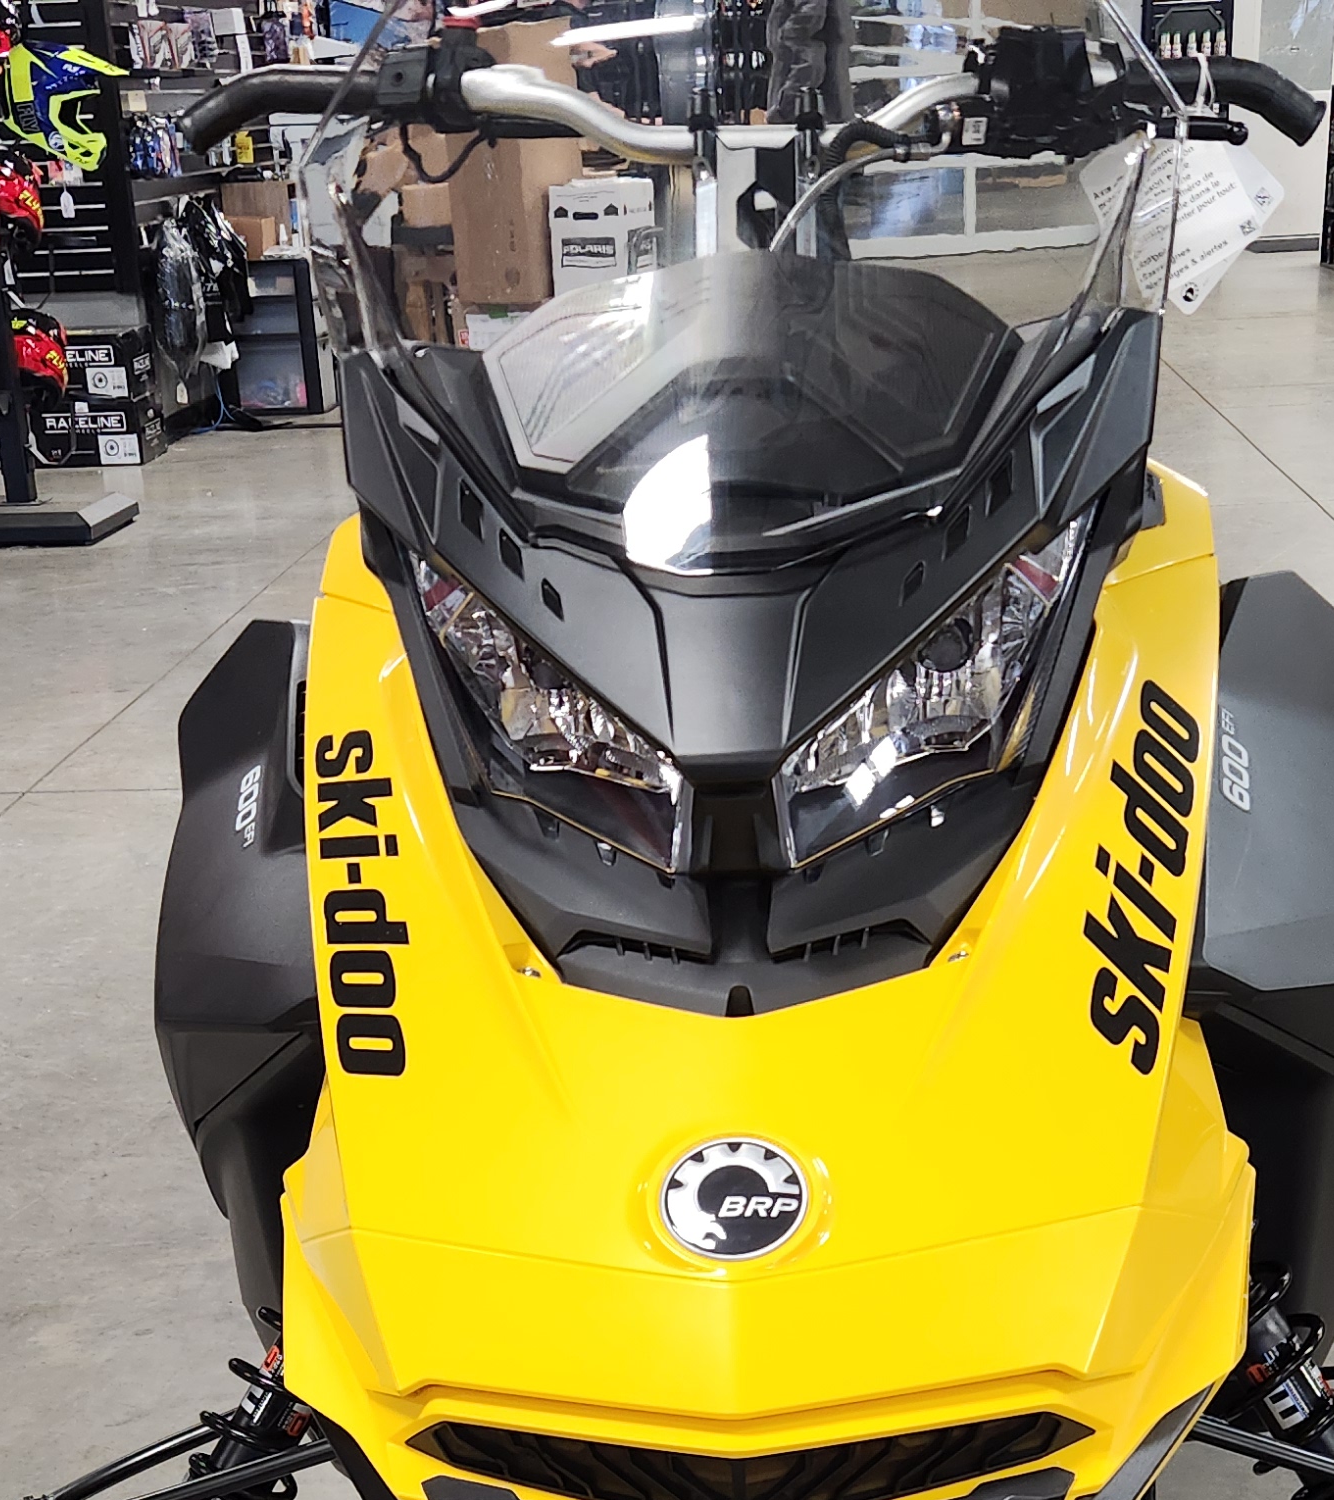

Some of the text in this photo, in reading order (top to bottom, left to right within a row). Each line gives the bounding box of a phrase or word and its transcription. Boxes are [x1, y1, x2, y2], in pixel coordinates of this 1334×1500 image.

[562, 244, 616, 255] POLARIS
[63, 349, 110, 362] ELINE
[1220, 707, 1251, 812] 600 EFI
[235, 764, 262, 848] 600 EFI
[315, 729, 410, 1078] ski-doo
[1082, 679, 1201, 1077] ski-doo
[717, 1195, 800, 1218] BRP
